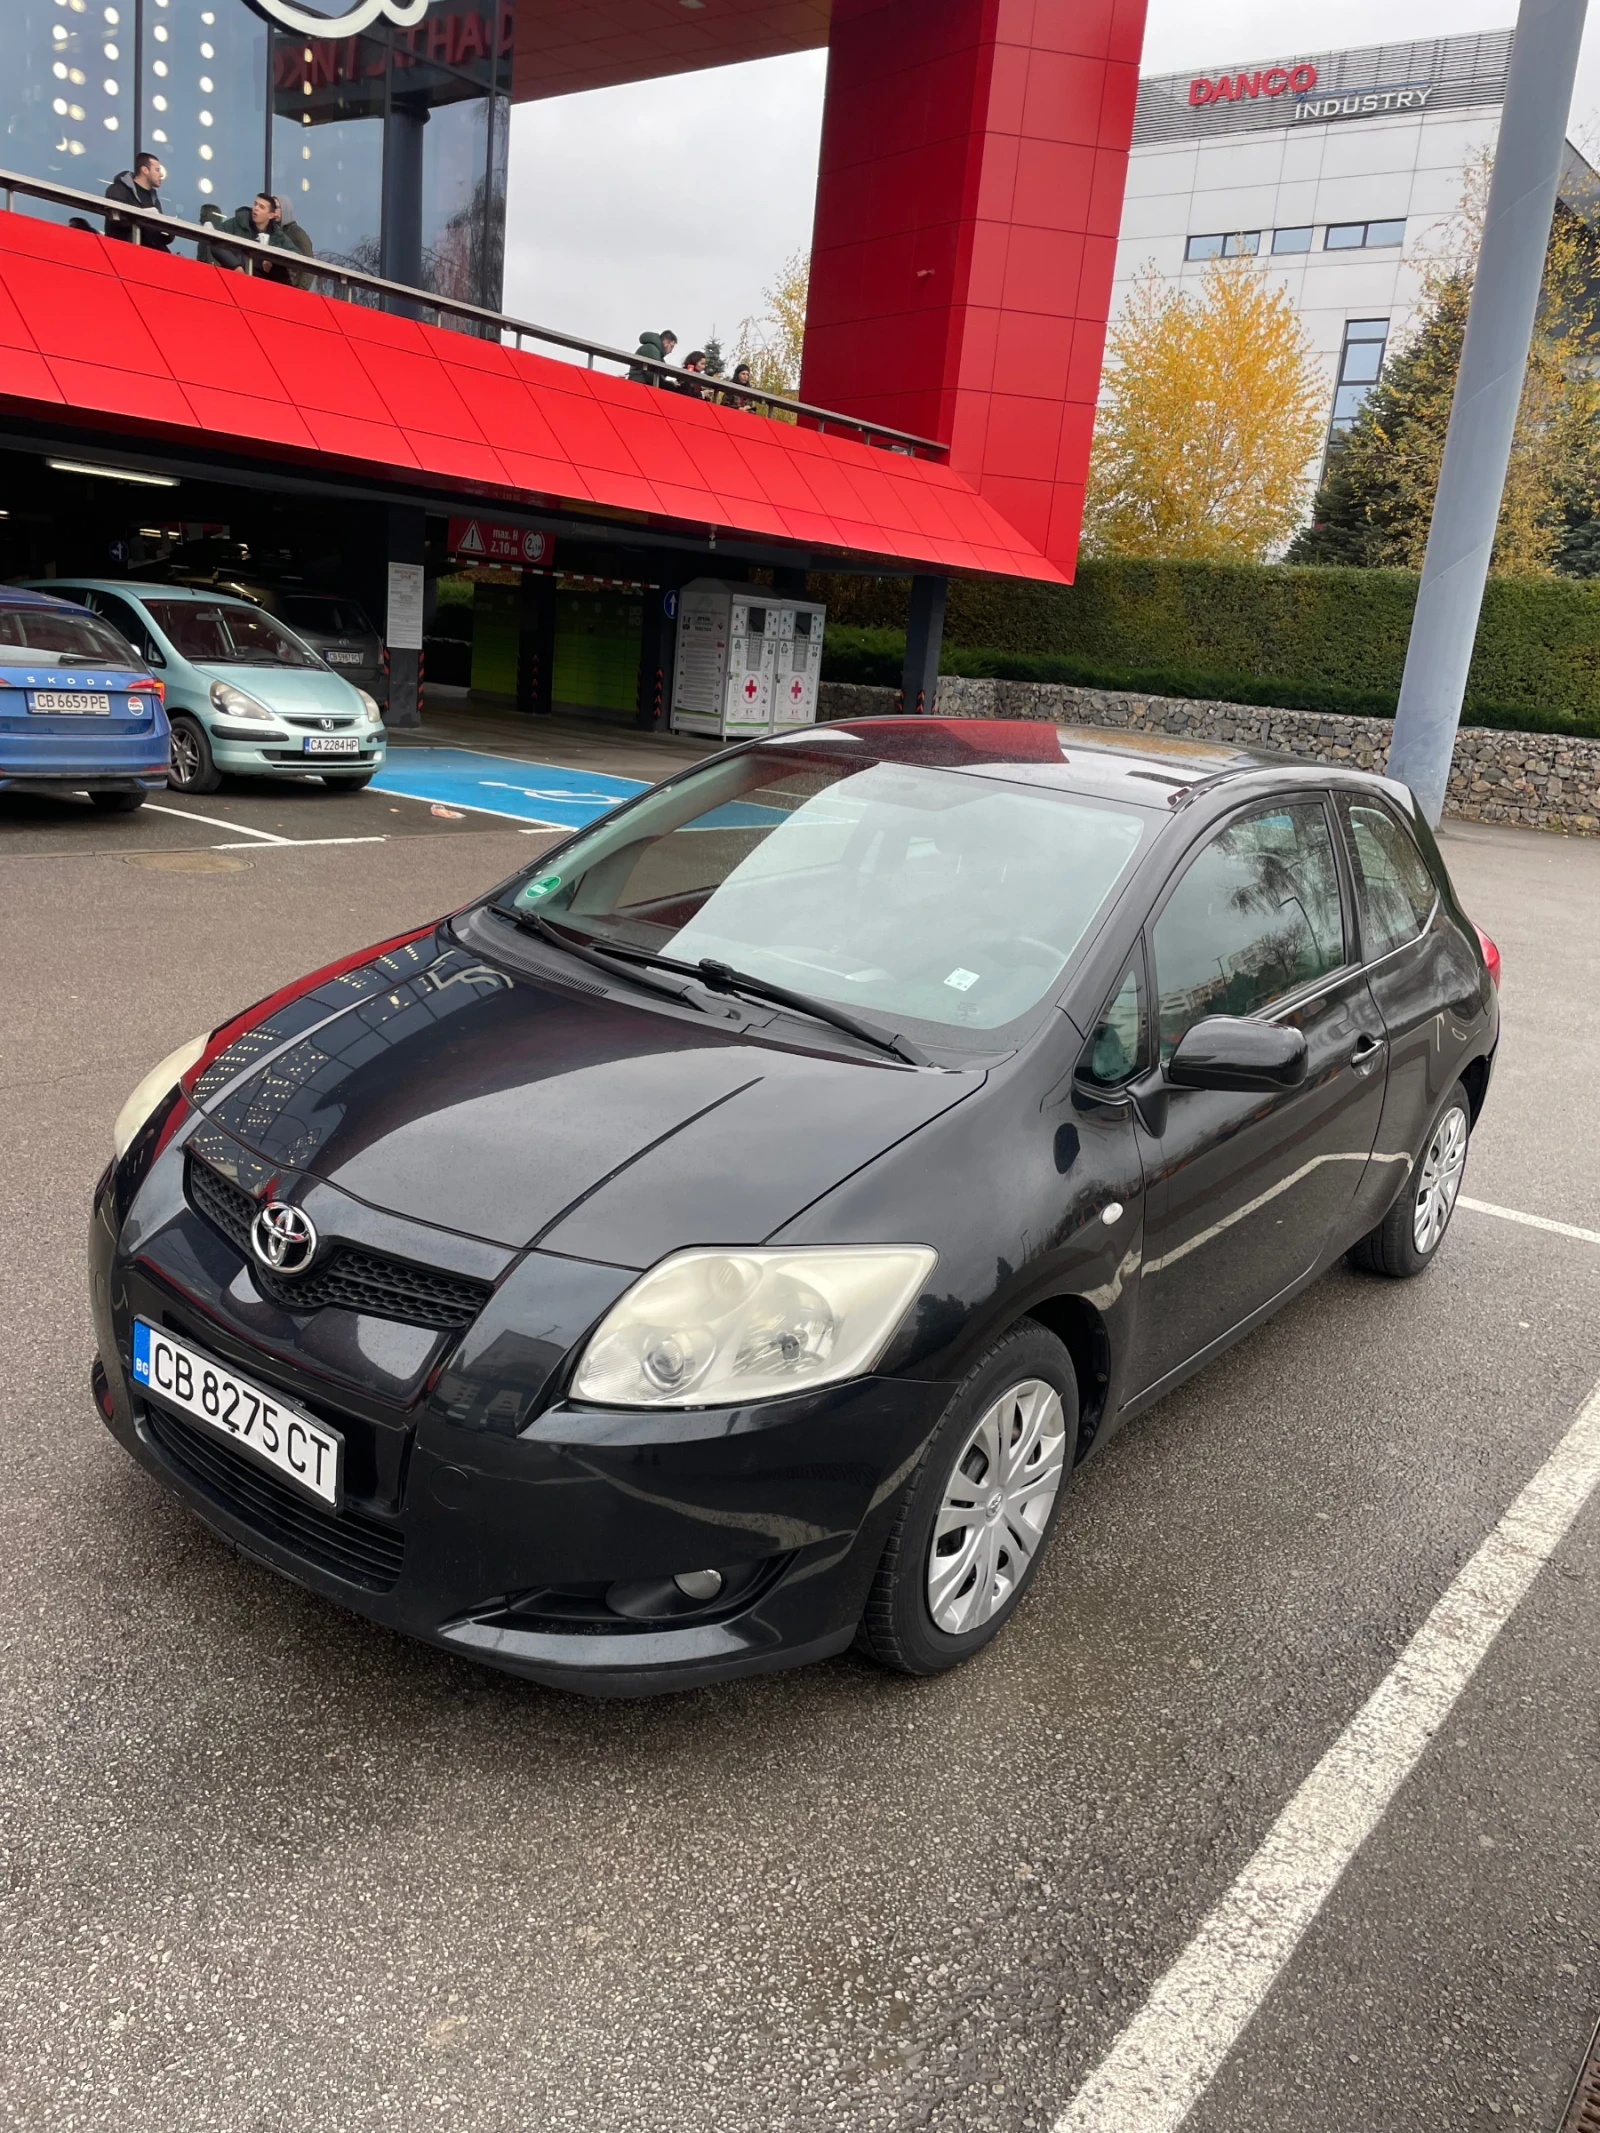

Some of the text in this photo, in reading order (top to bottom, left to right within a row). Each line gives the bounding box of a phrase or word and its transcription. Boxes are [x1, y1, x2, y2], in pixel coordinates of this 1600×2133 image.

[1188, 63, 1318, 106] DANCO
[1294, 84, 1433, 119] INDUSTRY
[492, 528, 519, 541] max. H
[490, 540, 518, 556] 2.10 m
[26, 676, 113, 686] SKODA
[36, 694, 107, 710] CB 6659 PE
[310, 739, 357, 751] CA 2284 HP
[135, 1357, 149, 1376] BG
[155, 1342, 330, 1487] CB 8275 CT
